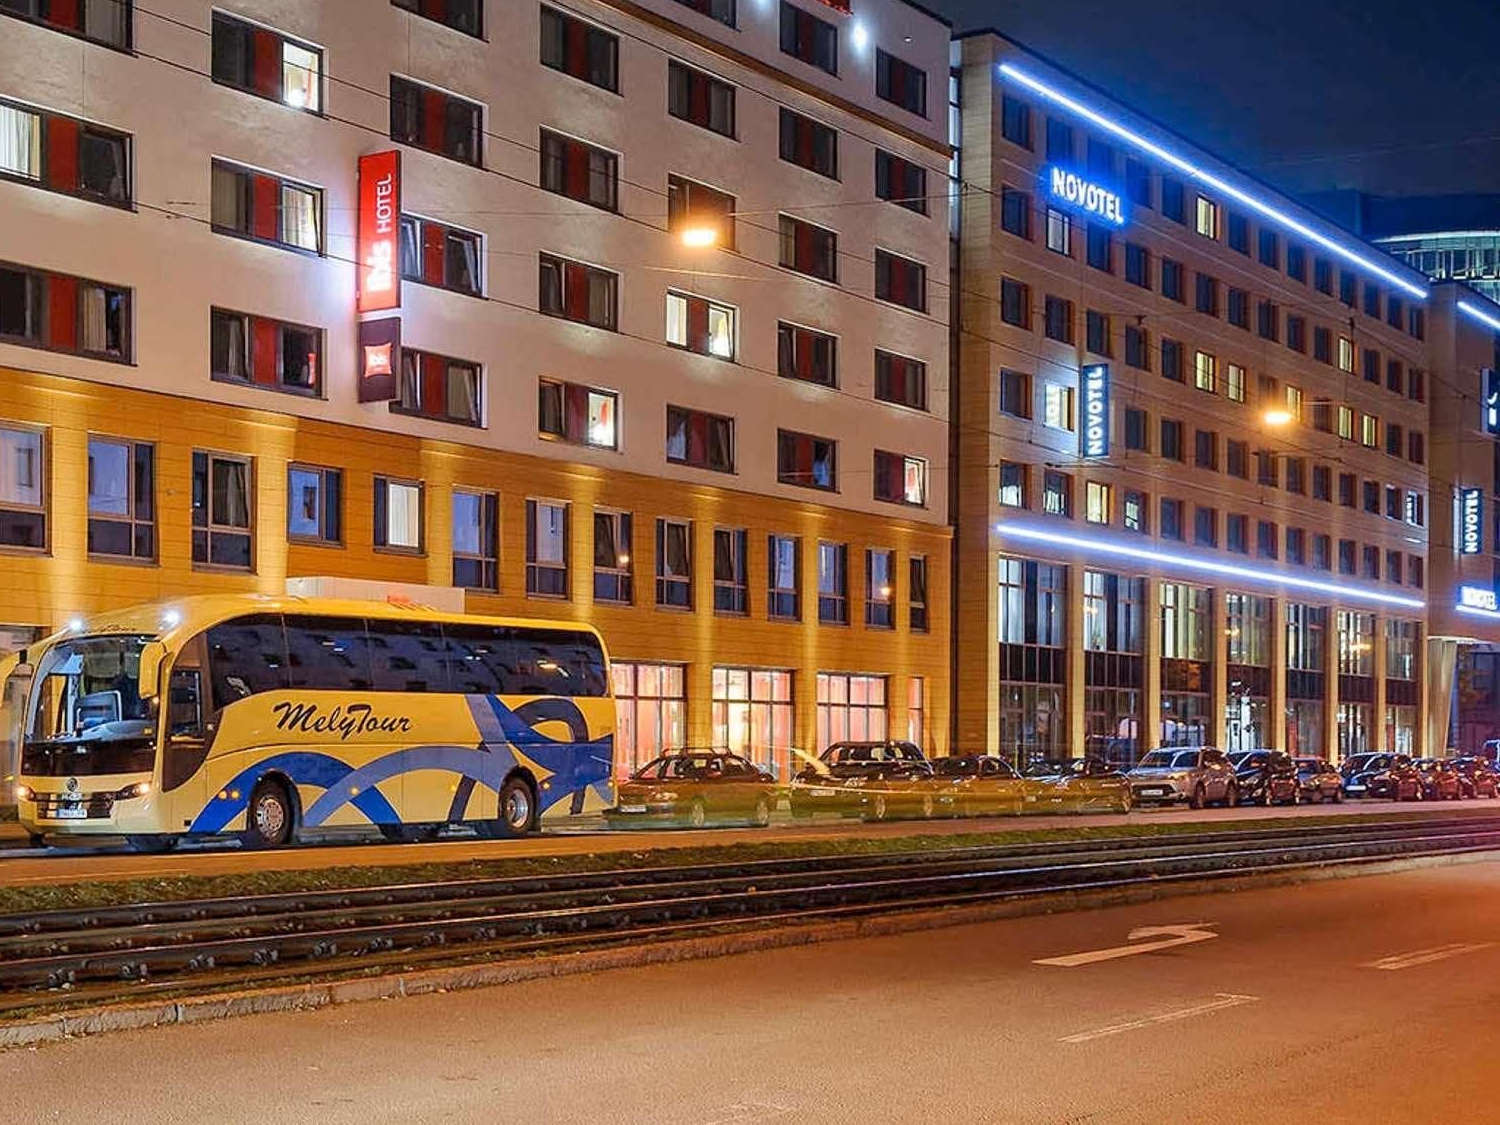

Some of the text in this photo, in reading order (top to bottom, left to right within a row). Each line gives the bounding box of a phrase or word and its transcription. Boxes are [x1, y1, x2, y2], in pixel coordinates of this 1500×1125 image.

[376, 173, 392, 234] HOTEL
[1051, 165, 1125, 225] NOVOTEL
[1086, 366, 1104, 456] NOVOTEL
[1464, 490, 1479, 553] NOVOTEL
